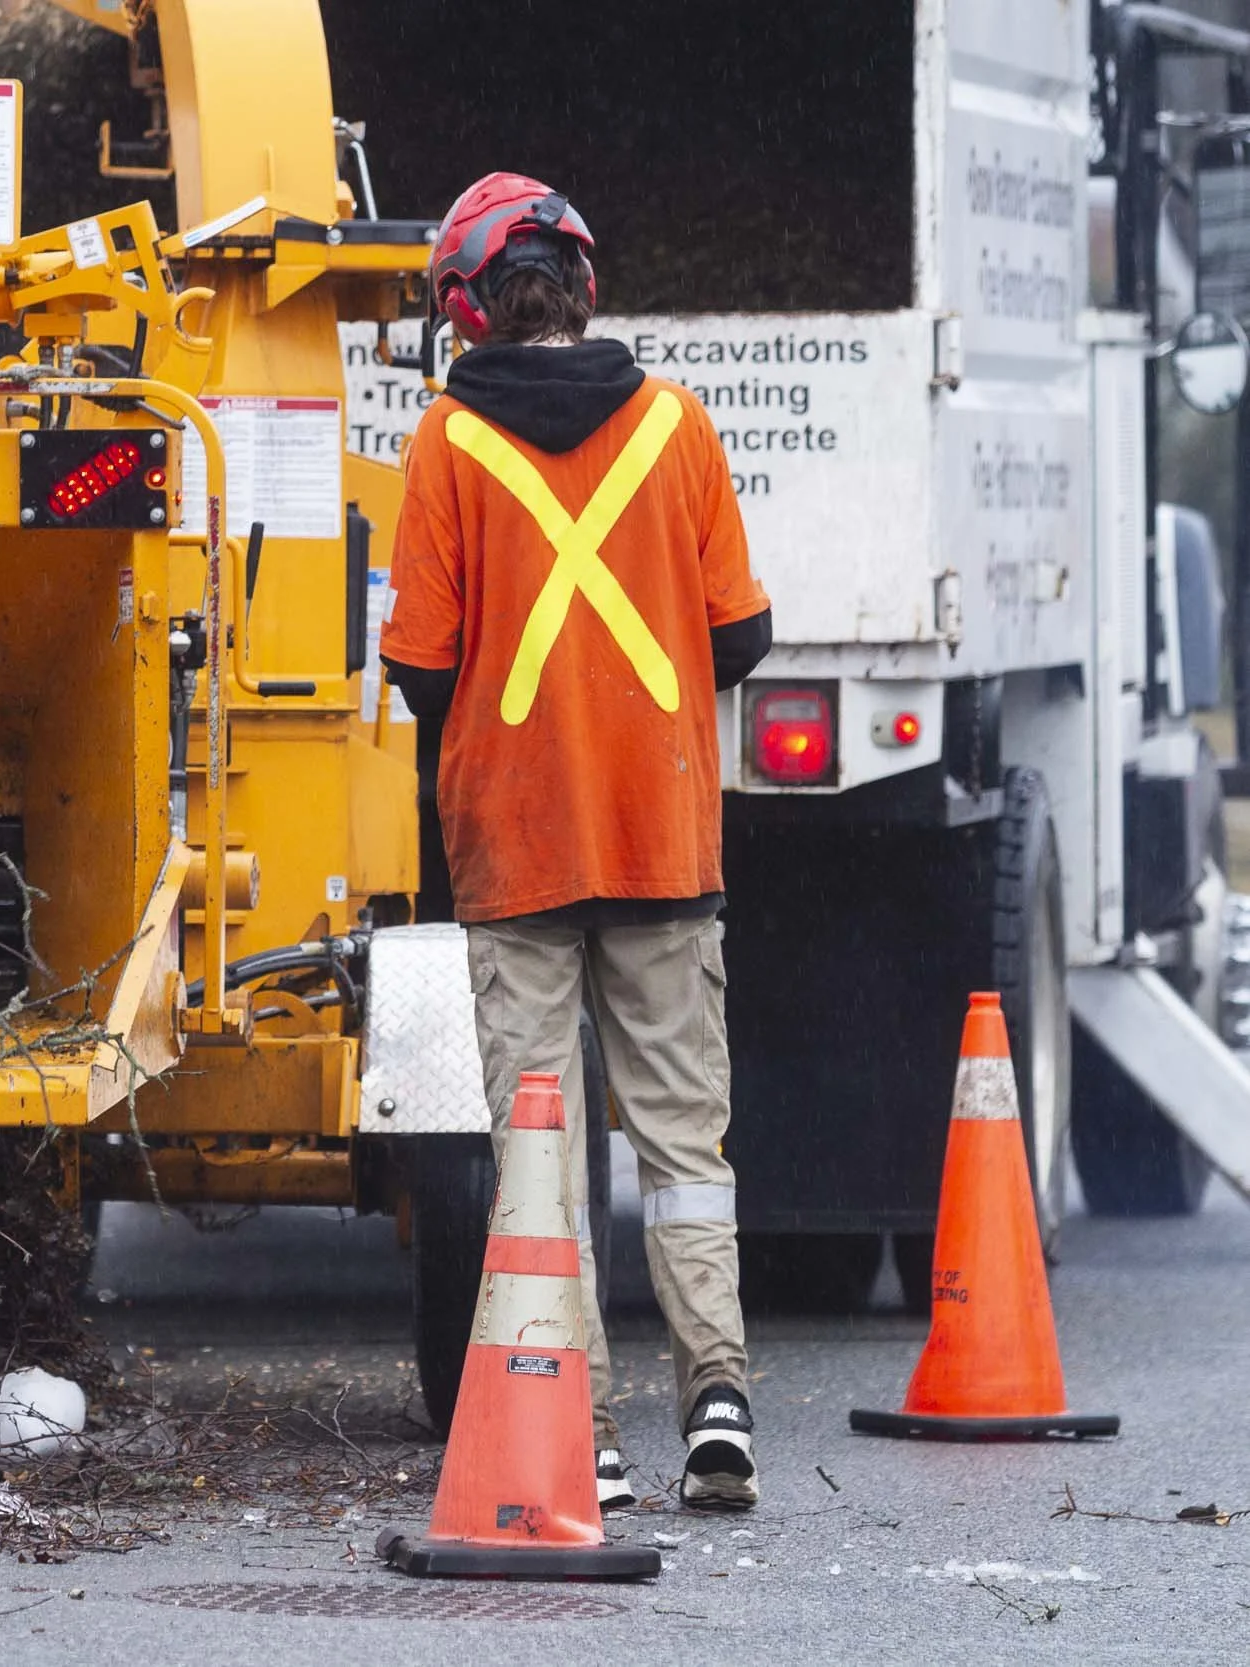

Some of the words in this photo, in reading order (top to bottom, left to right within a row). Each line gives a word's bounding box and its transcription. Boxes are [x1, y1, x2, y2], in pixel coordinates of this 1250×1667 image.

[634, 333, 869, 364] Excavations
[378, 379, 434, 409] Tre
[682, 378, 810, 415] anting
[720, 423, 837, 452] ncrete
[704, 1402, 741, 1421] NIKE
